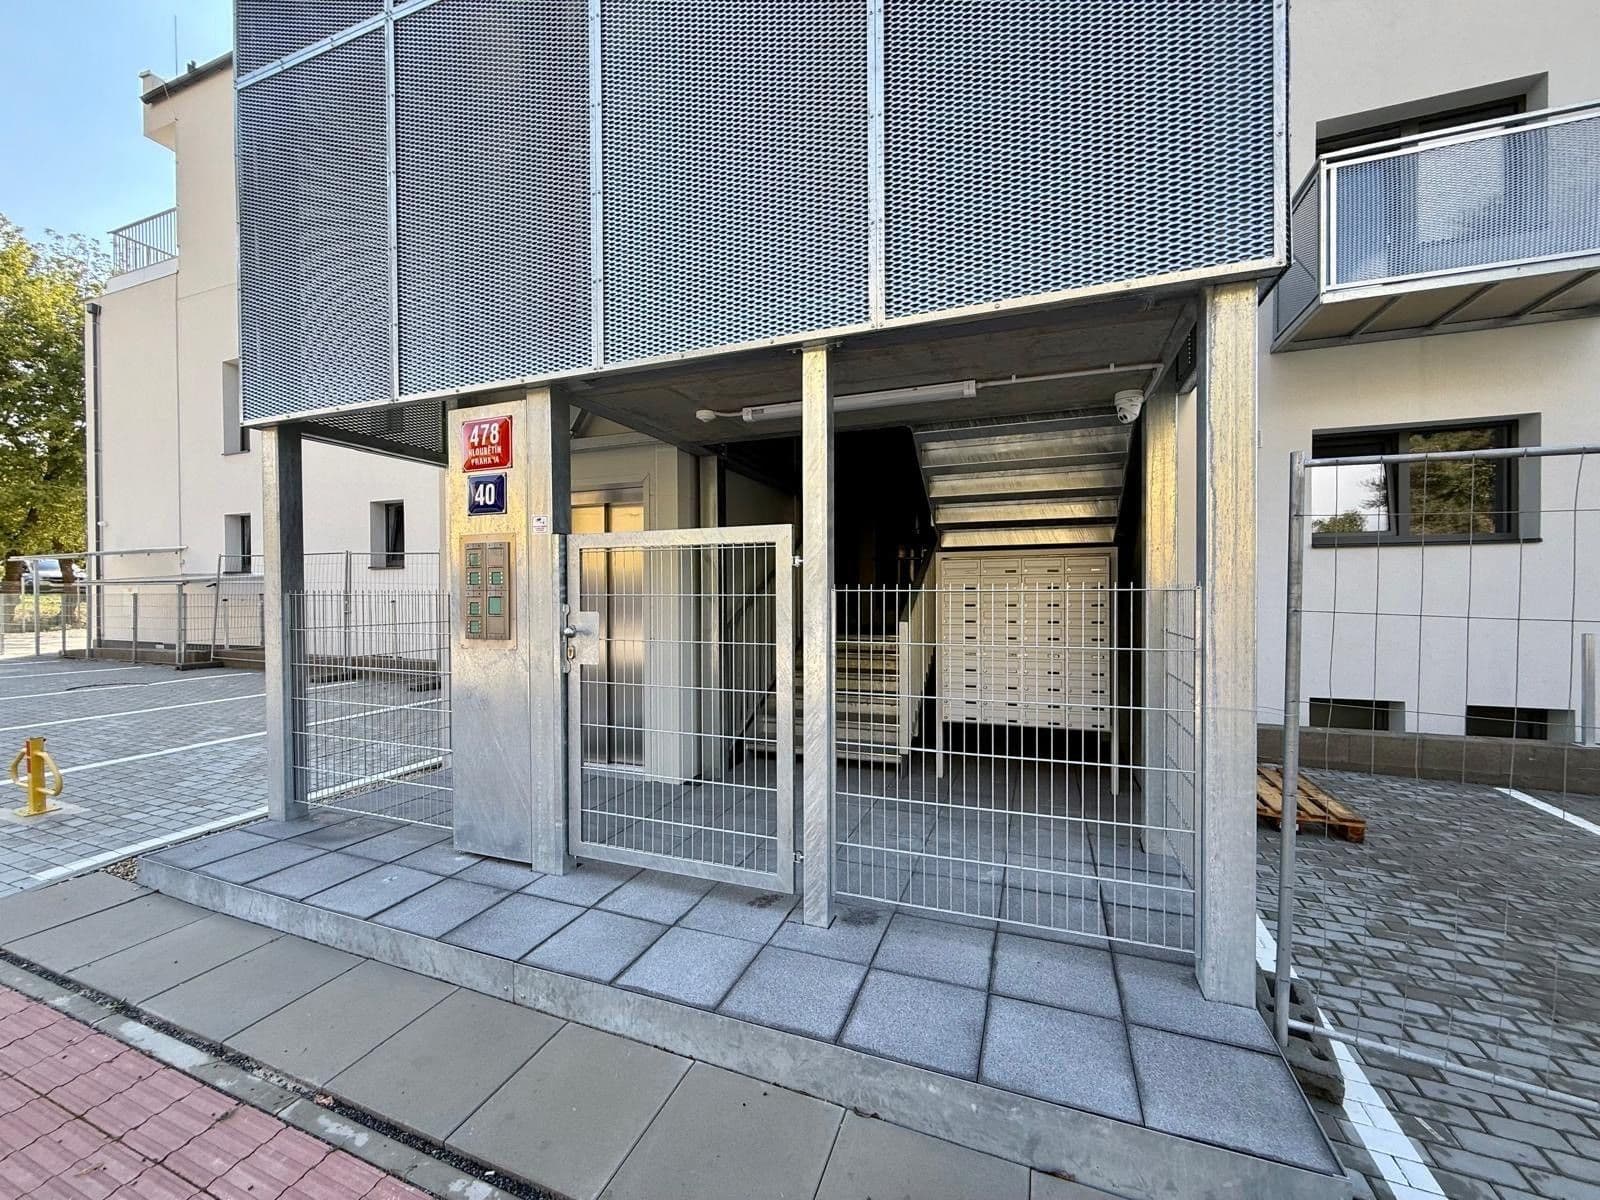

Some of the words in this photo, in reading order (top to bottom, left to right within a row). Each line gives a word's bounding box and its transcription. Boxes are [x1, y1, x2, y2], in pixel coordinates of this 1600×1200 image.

[470, 423, 500, 446] 478
[471, 456, 492, 466] PRAHA
[474, 483, 495, 506] 40
